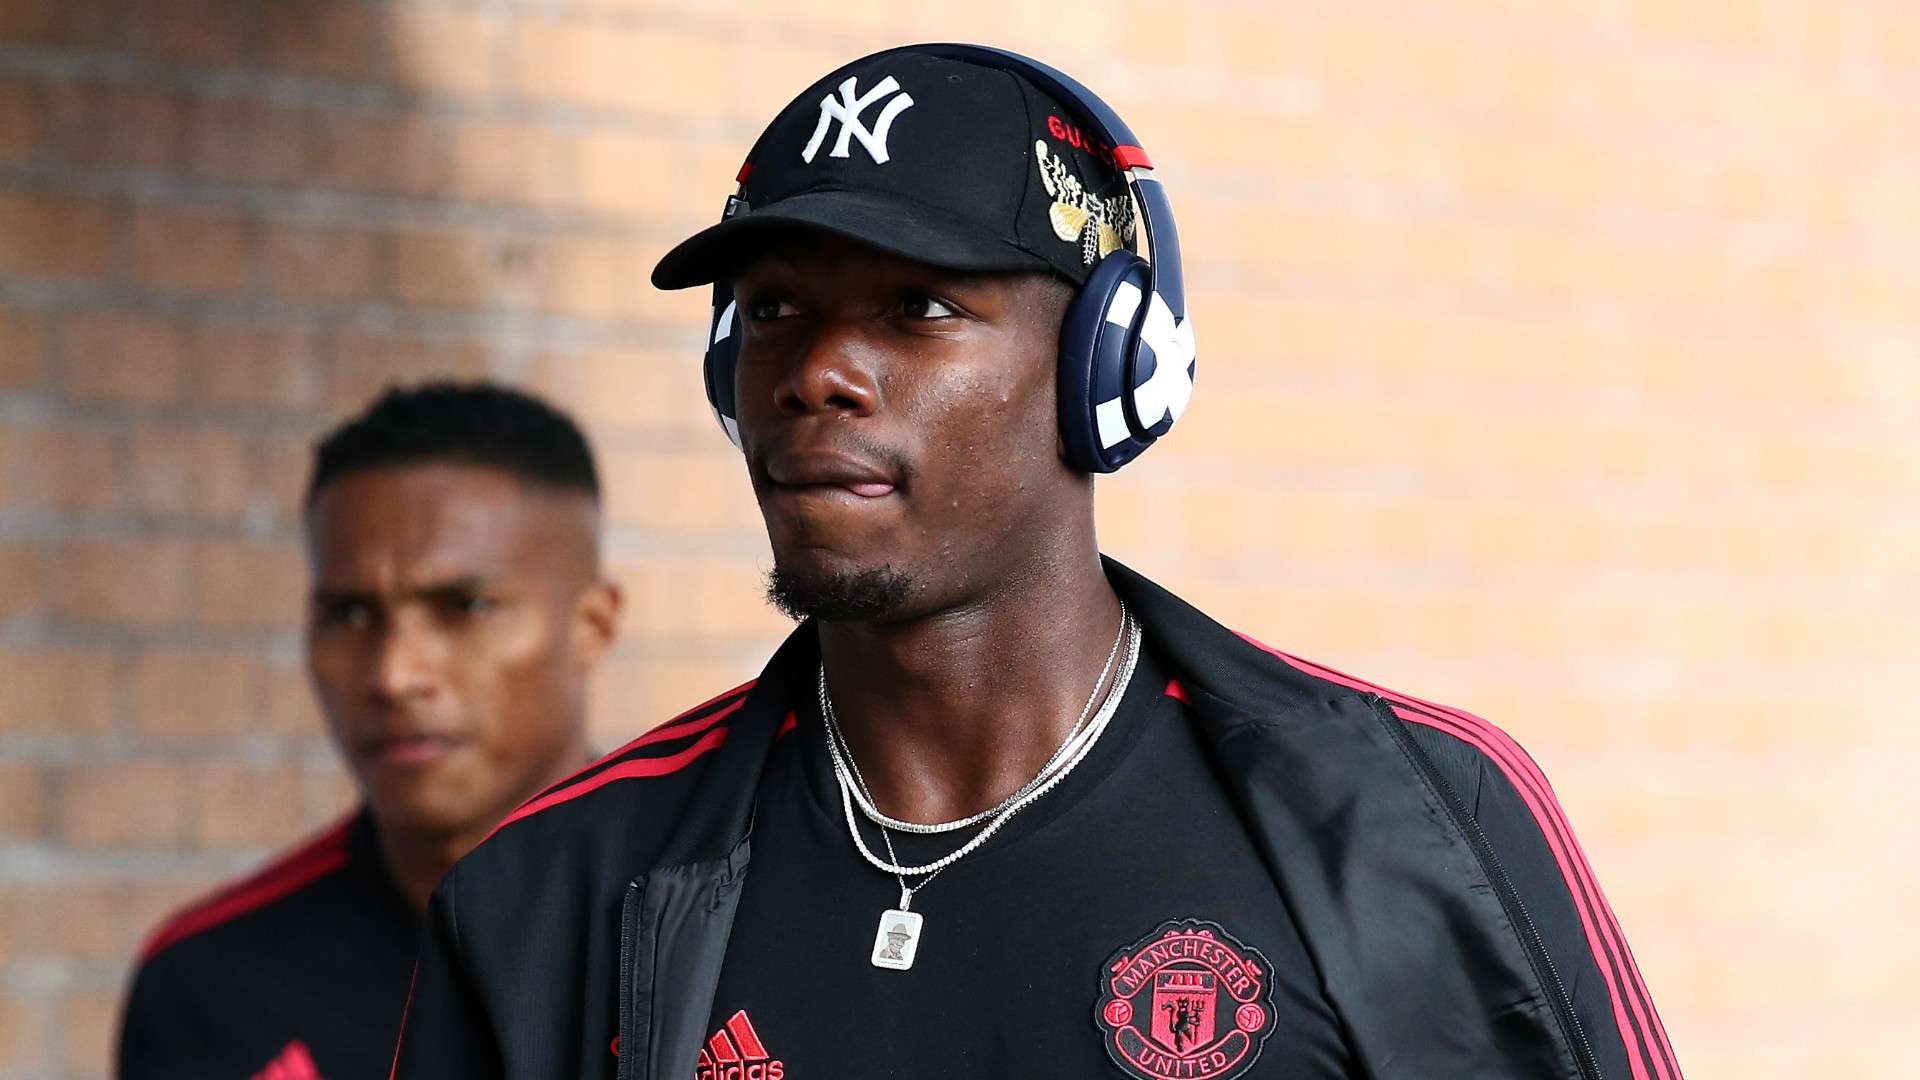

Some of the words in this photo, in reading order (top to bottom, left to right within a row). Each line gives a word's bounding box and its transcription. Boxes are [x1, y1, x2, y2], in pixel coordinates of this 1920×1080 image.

[801, 75, 914, 165] NY
[1121, 940, 1250, 995] MANCHESTER
[1138, 1047, 1227, 1077] UNITED
